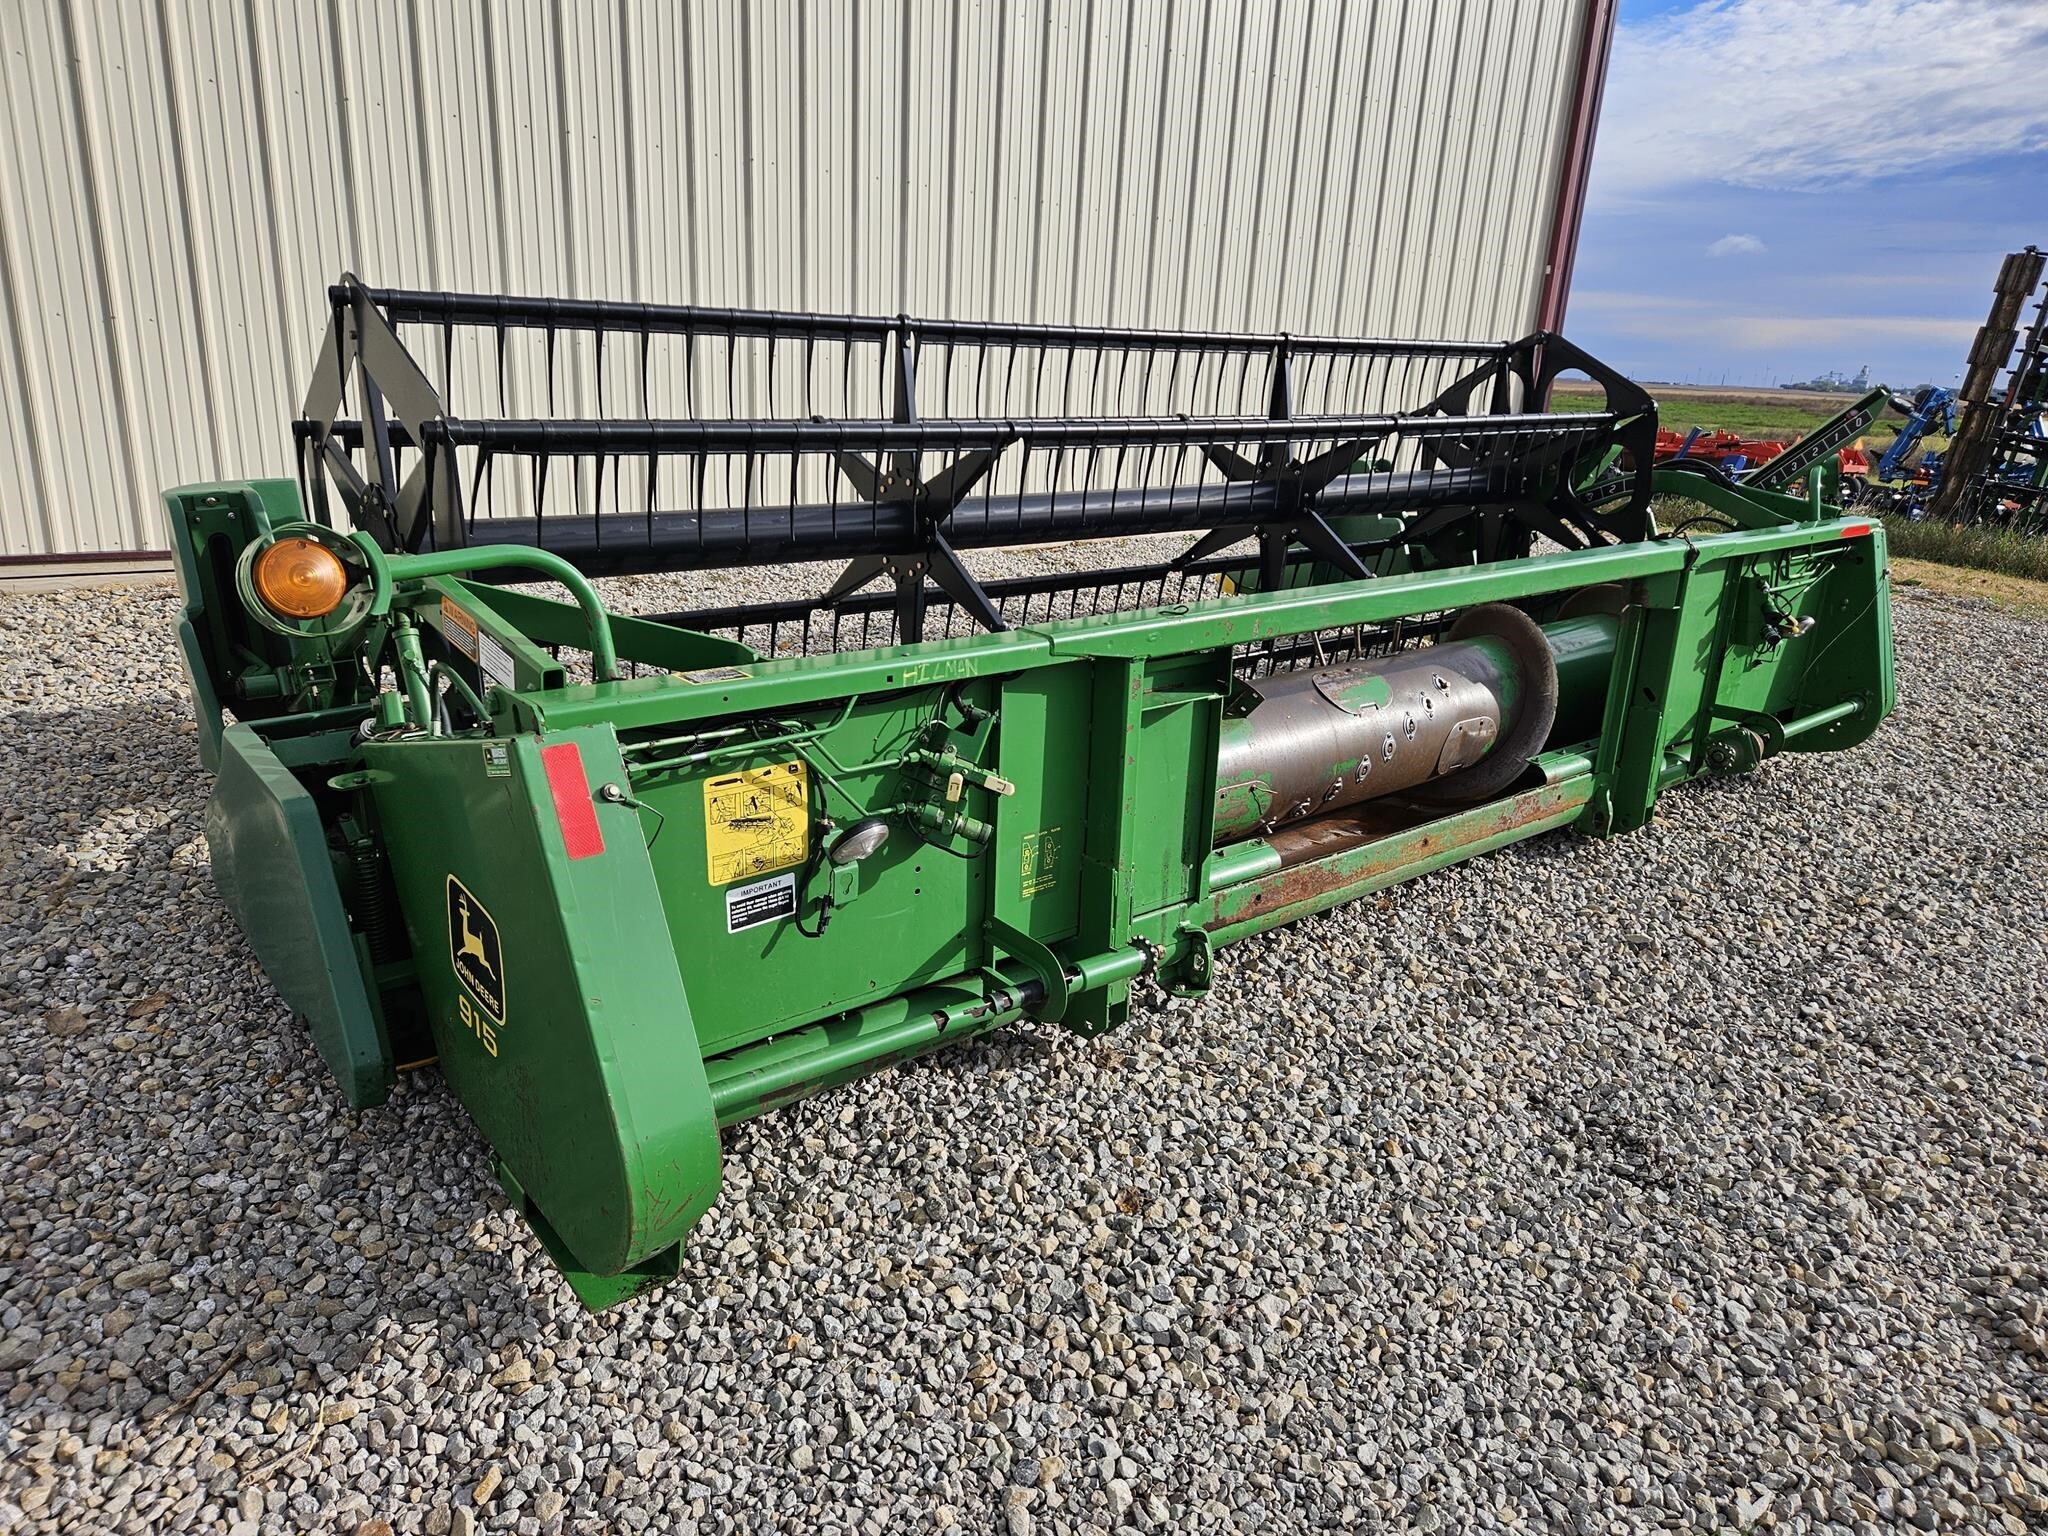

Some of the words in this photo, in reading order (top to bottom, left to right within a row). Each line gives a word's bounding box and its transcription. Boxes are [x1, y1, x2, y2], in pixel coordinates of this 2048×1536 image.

[1791, 462, 1797, 471] 3
[1812, 447, 1819, 457] 2
[1855, 418, 1862, 427] 0
[1609, 484, 1616, 493] 2
[741, 881, 782, 896] IMPORTANT
[456, 959, 475, 987] JOHN
[475, 979, 500, 1014] DEERE
[458, 993, 498, 1058] 915
